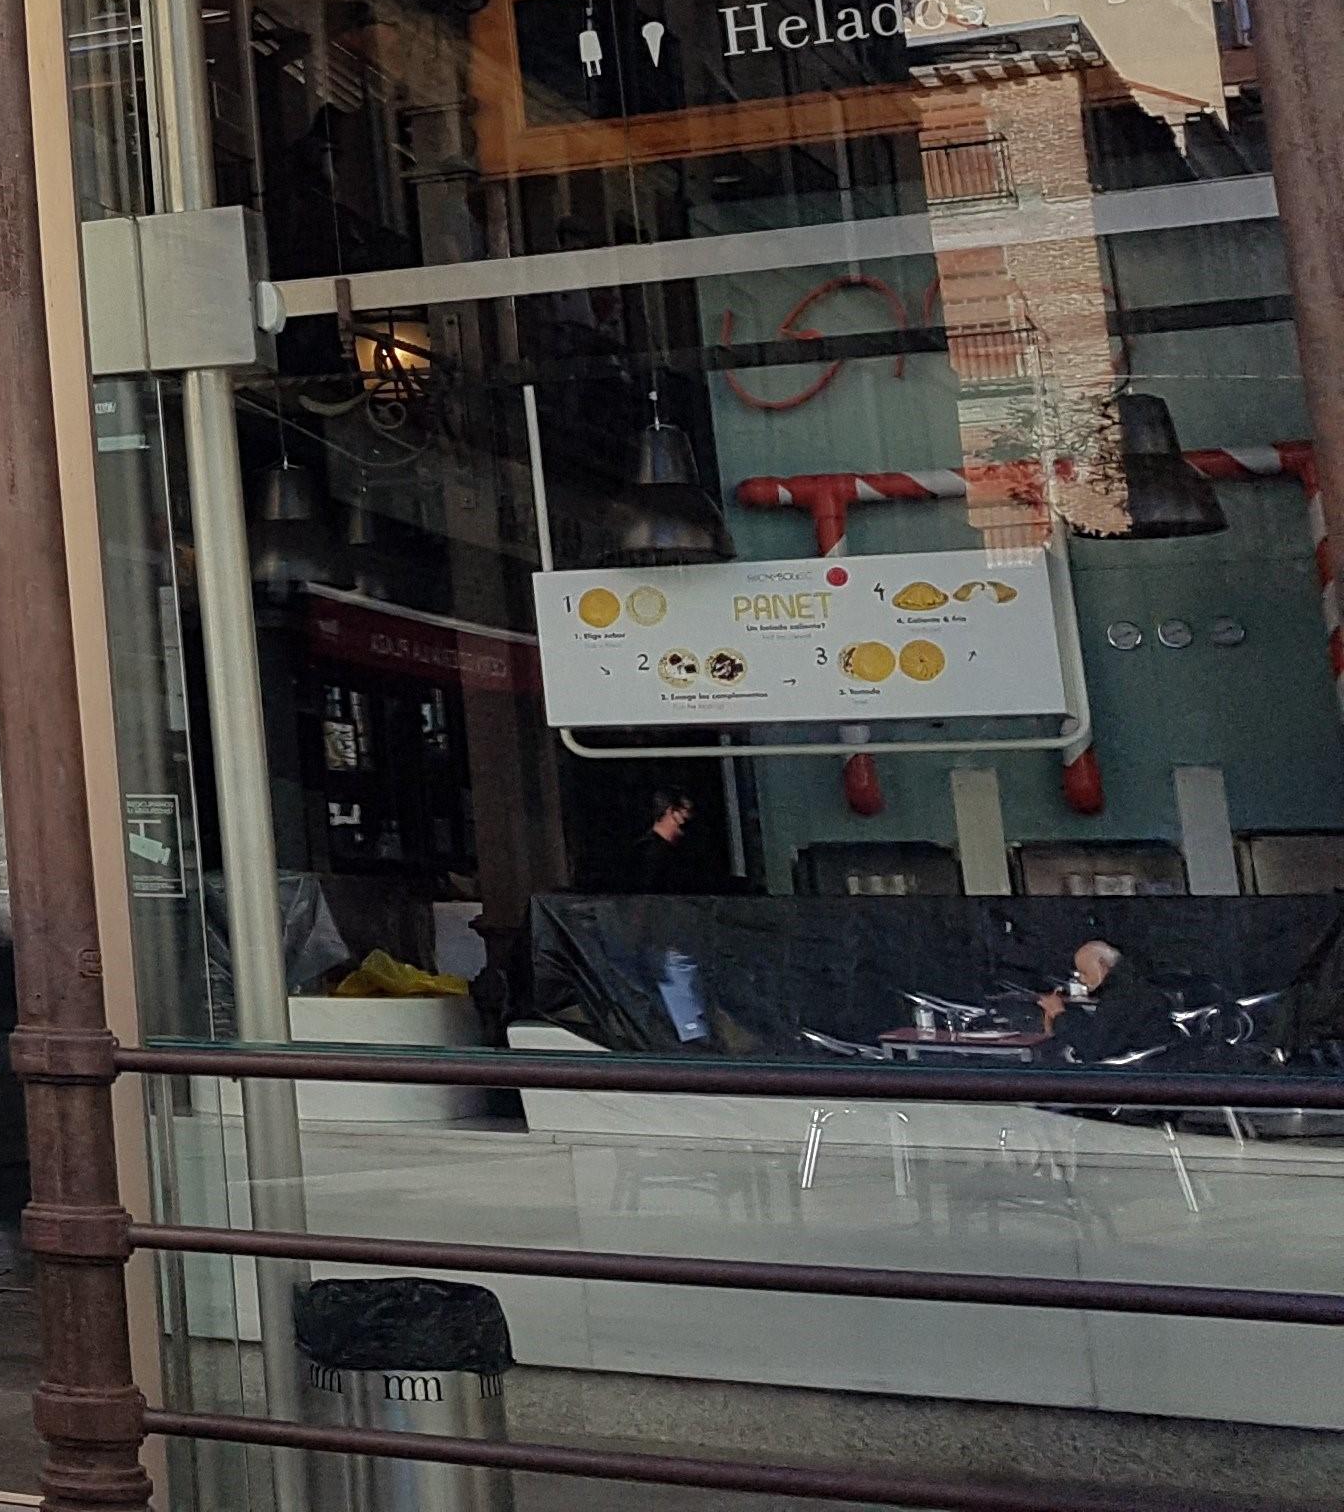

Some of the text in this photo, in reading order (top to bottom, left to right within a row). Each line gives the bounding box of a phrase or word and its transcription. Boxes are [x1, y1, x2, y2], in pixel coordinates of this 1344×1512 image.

[873, 582, 885, 601] 4
[732, 591, 833, 622] PANET
[636, 653, 650, 671] 2
[815, 646, 828, 666] 3
